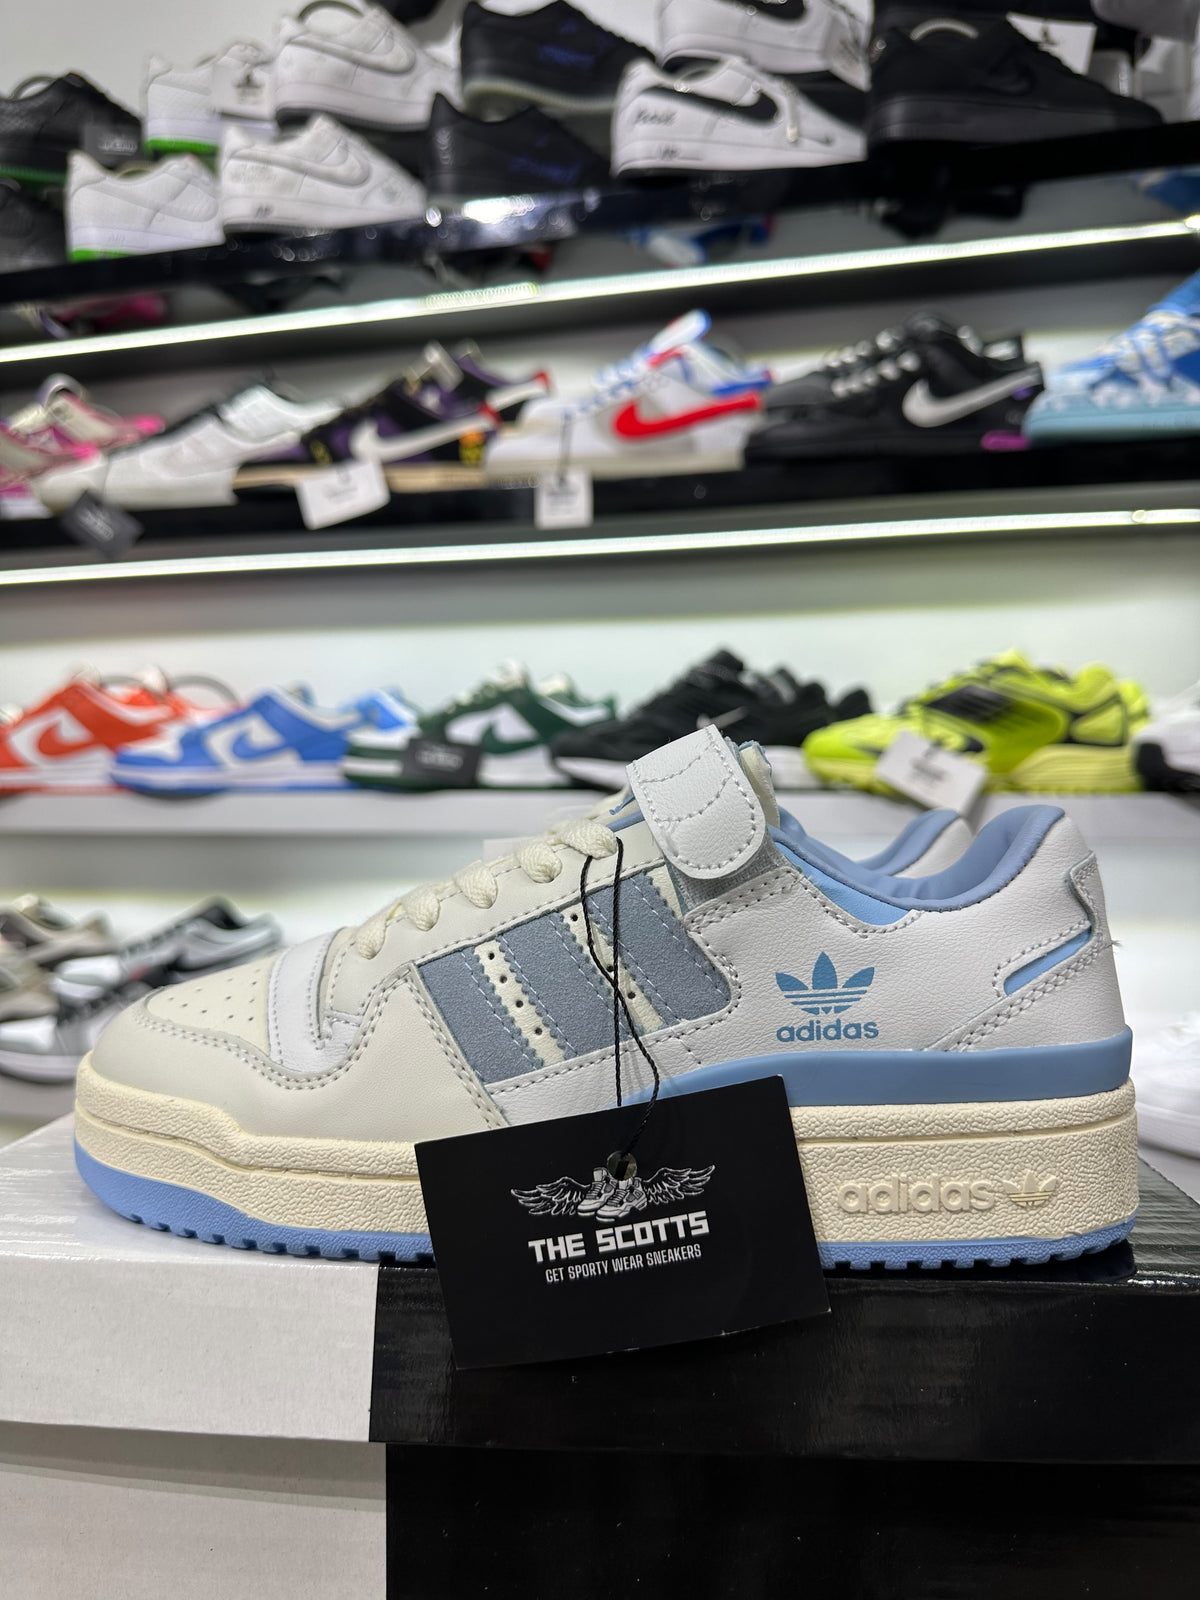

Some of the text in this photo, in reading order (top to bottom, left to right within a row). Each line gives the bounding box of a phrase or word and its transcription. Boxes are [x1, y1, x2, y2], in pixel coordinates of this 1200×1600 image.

[776, 1018, 879, 1043] adidas
[836, 1172, 996, 1214] adidas
[527, 1210, 710, 1263] THE SCOTTS
[545, 1243, 702, 1284] GET SPORTY WEAR SNEAKERS
